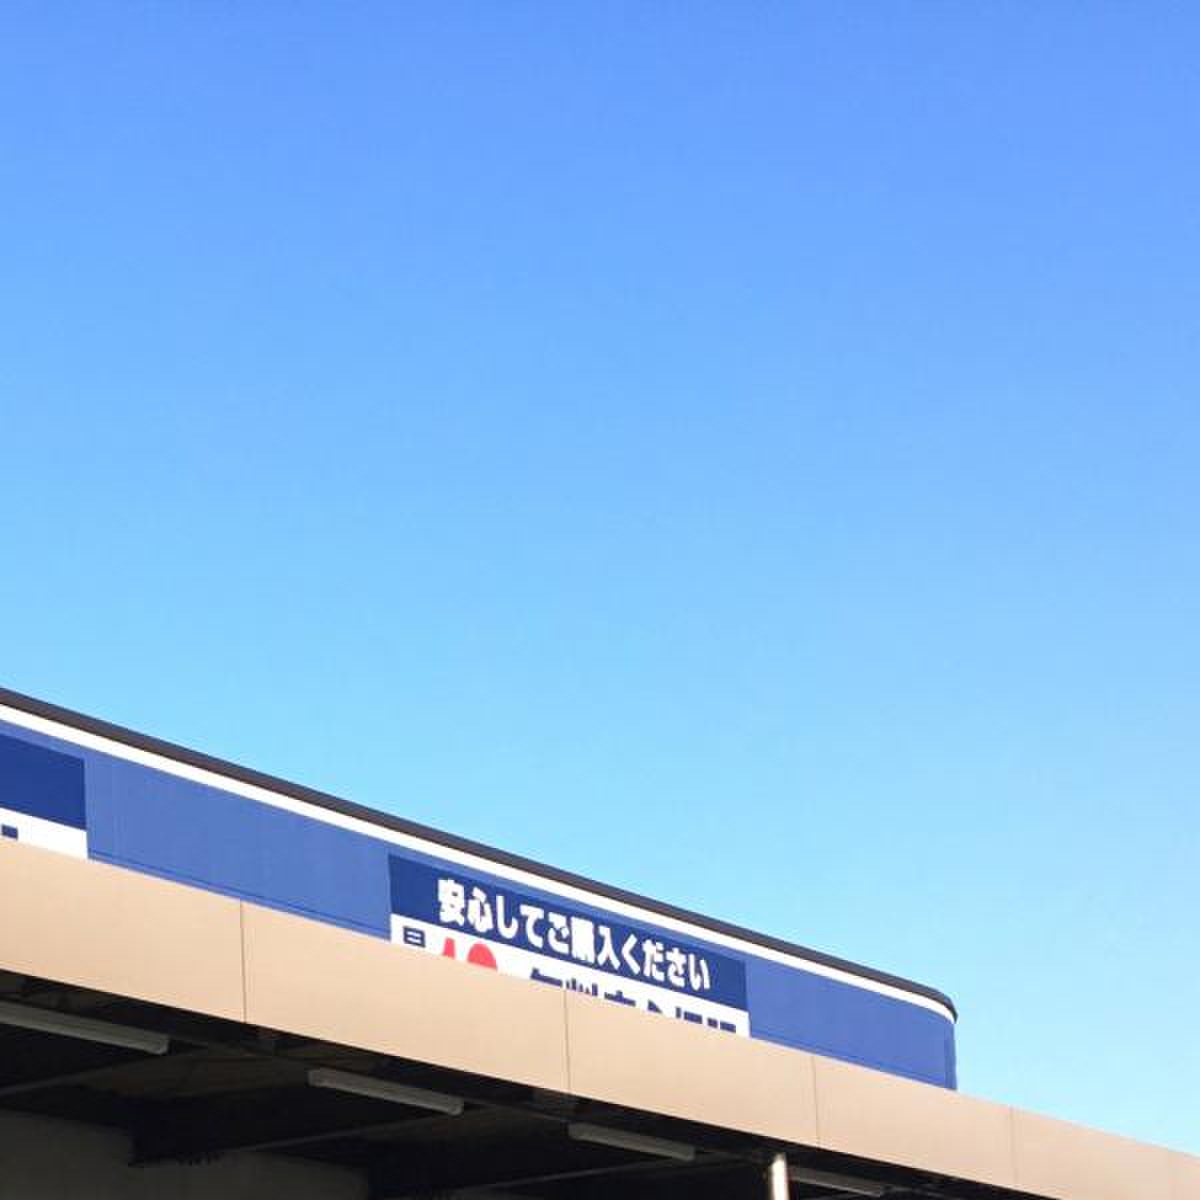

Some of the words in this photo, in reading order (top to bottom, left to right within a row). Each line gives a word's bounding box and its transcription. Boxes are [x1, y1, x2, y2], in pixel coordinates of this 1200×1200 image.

[436, 877, 712, 992] 安心してご購入ください
